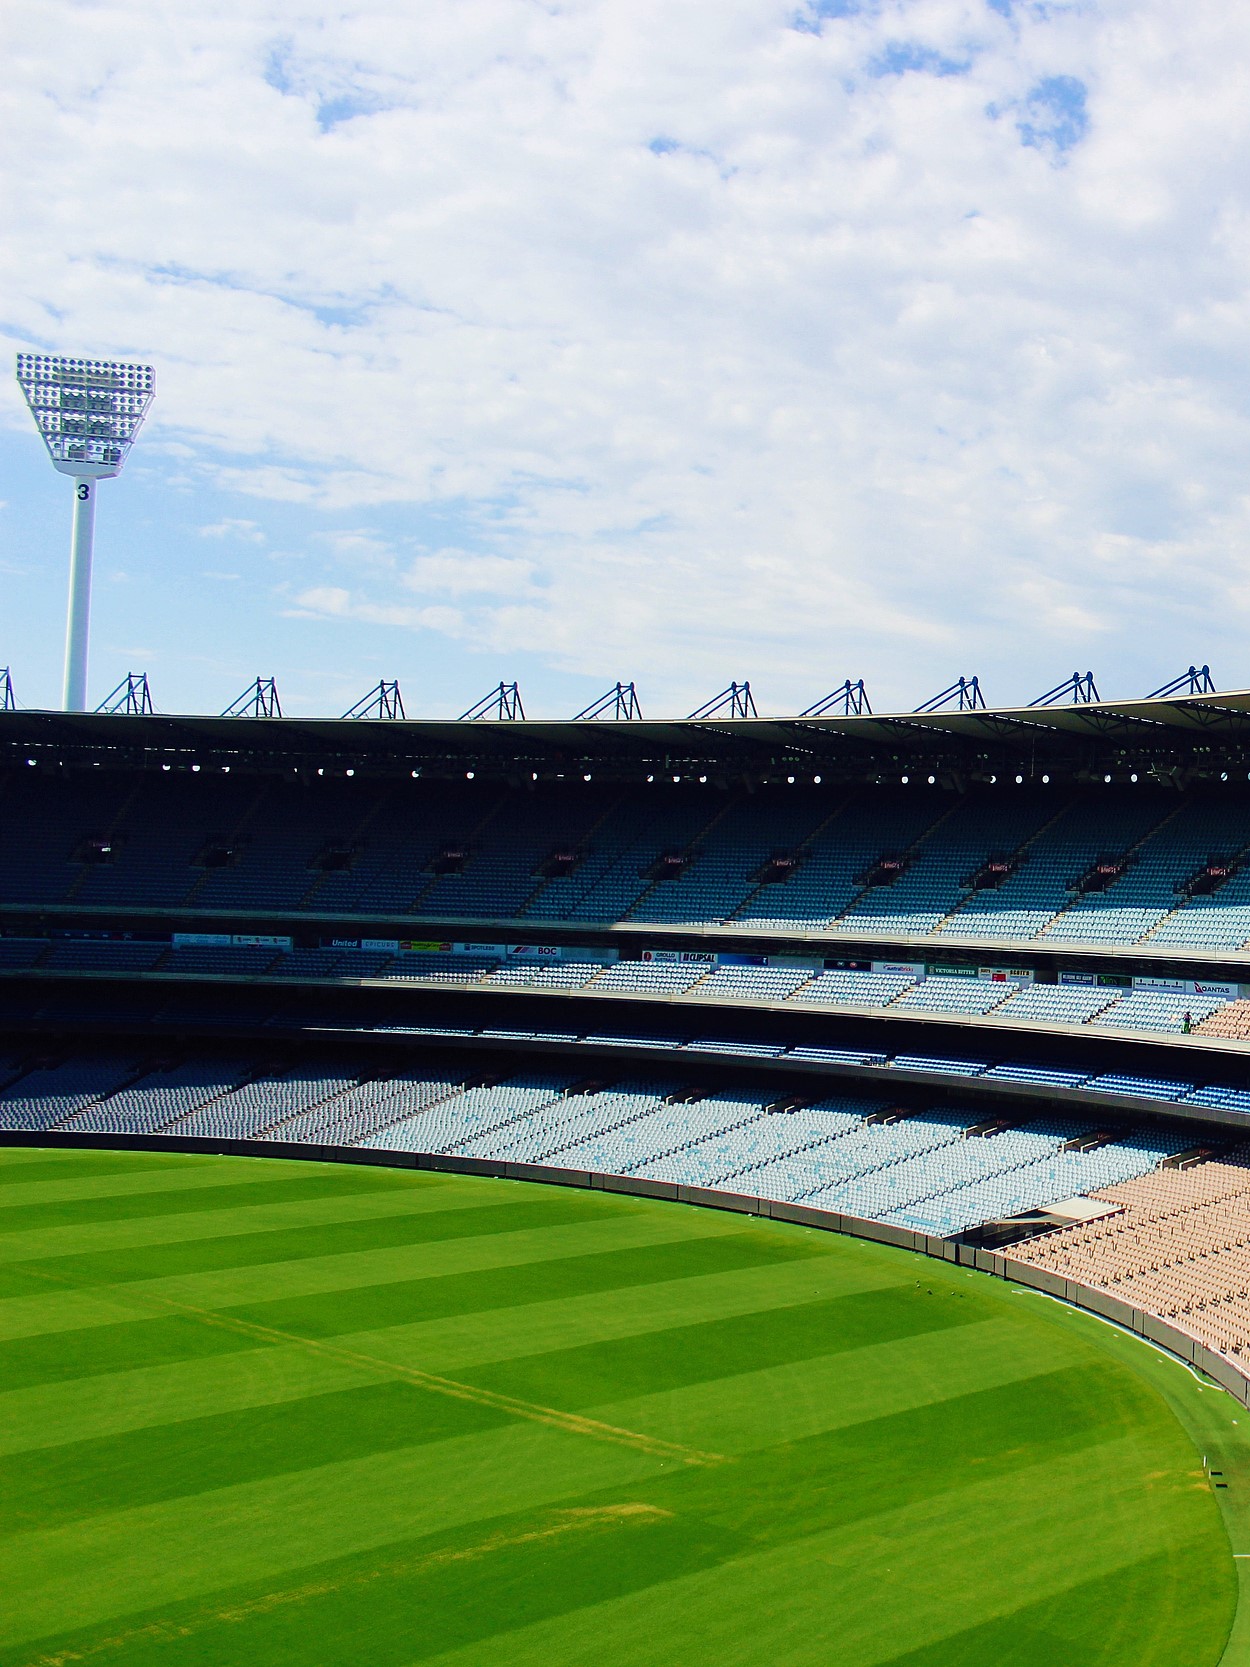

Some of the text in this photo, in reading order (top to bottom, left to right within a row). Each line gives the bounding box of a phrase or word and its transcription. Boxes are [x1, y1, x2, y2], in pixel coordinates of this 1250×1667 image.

[77, 483, 90, 501] 3
[332, 939, 357, 947] United
[537, 947, 557, 955] BOC
[690, 953, 715, 963] CLIPSAL
[935, 967, 958, 975] VICTORIA
